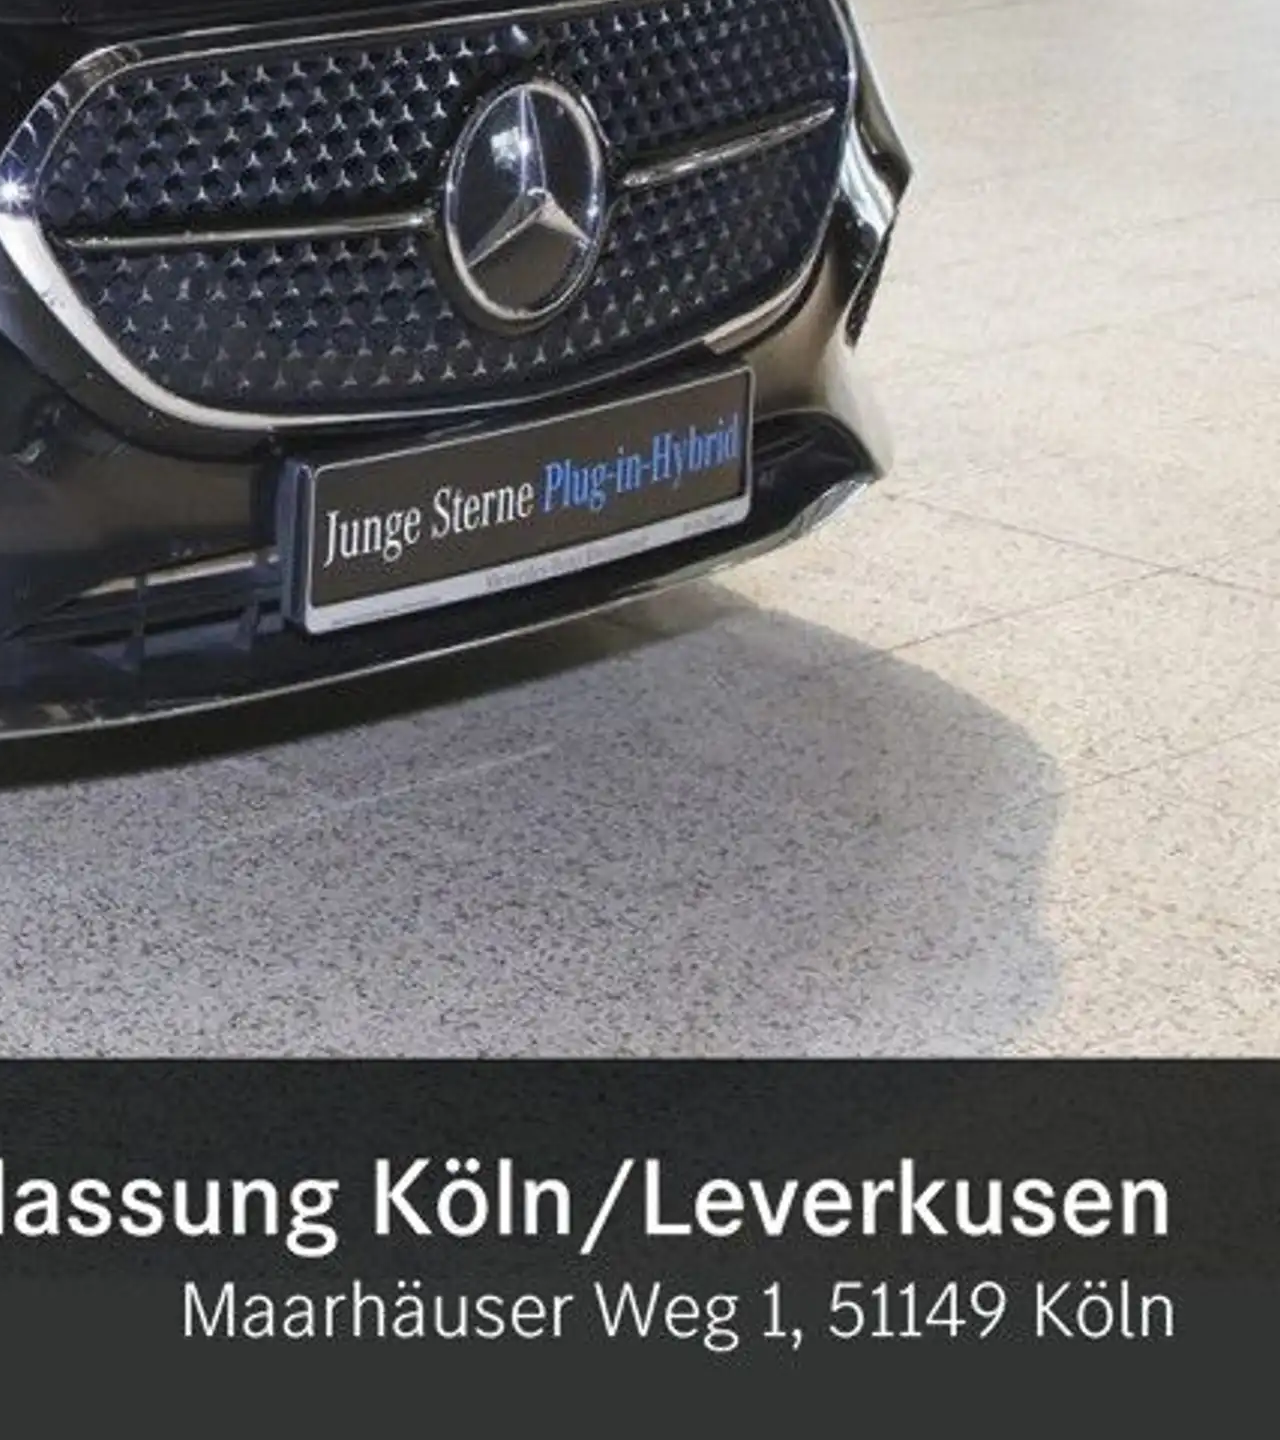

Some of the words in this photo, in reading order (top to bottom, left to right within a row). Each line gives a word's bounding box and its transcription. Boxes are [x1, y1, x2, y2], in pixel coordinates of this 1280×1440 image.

[323, 506, 422, 569] Junge
[430, 480, 535, 539] Sterne
[544, 411, 740, 514] Plug-in-Hybrid
